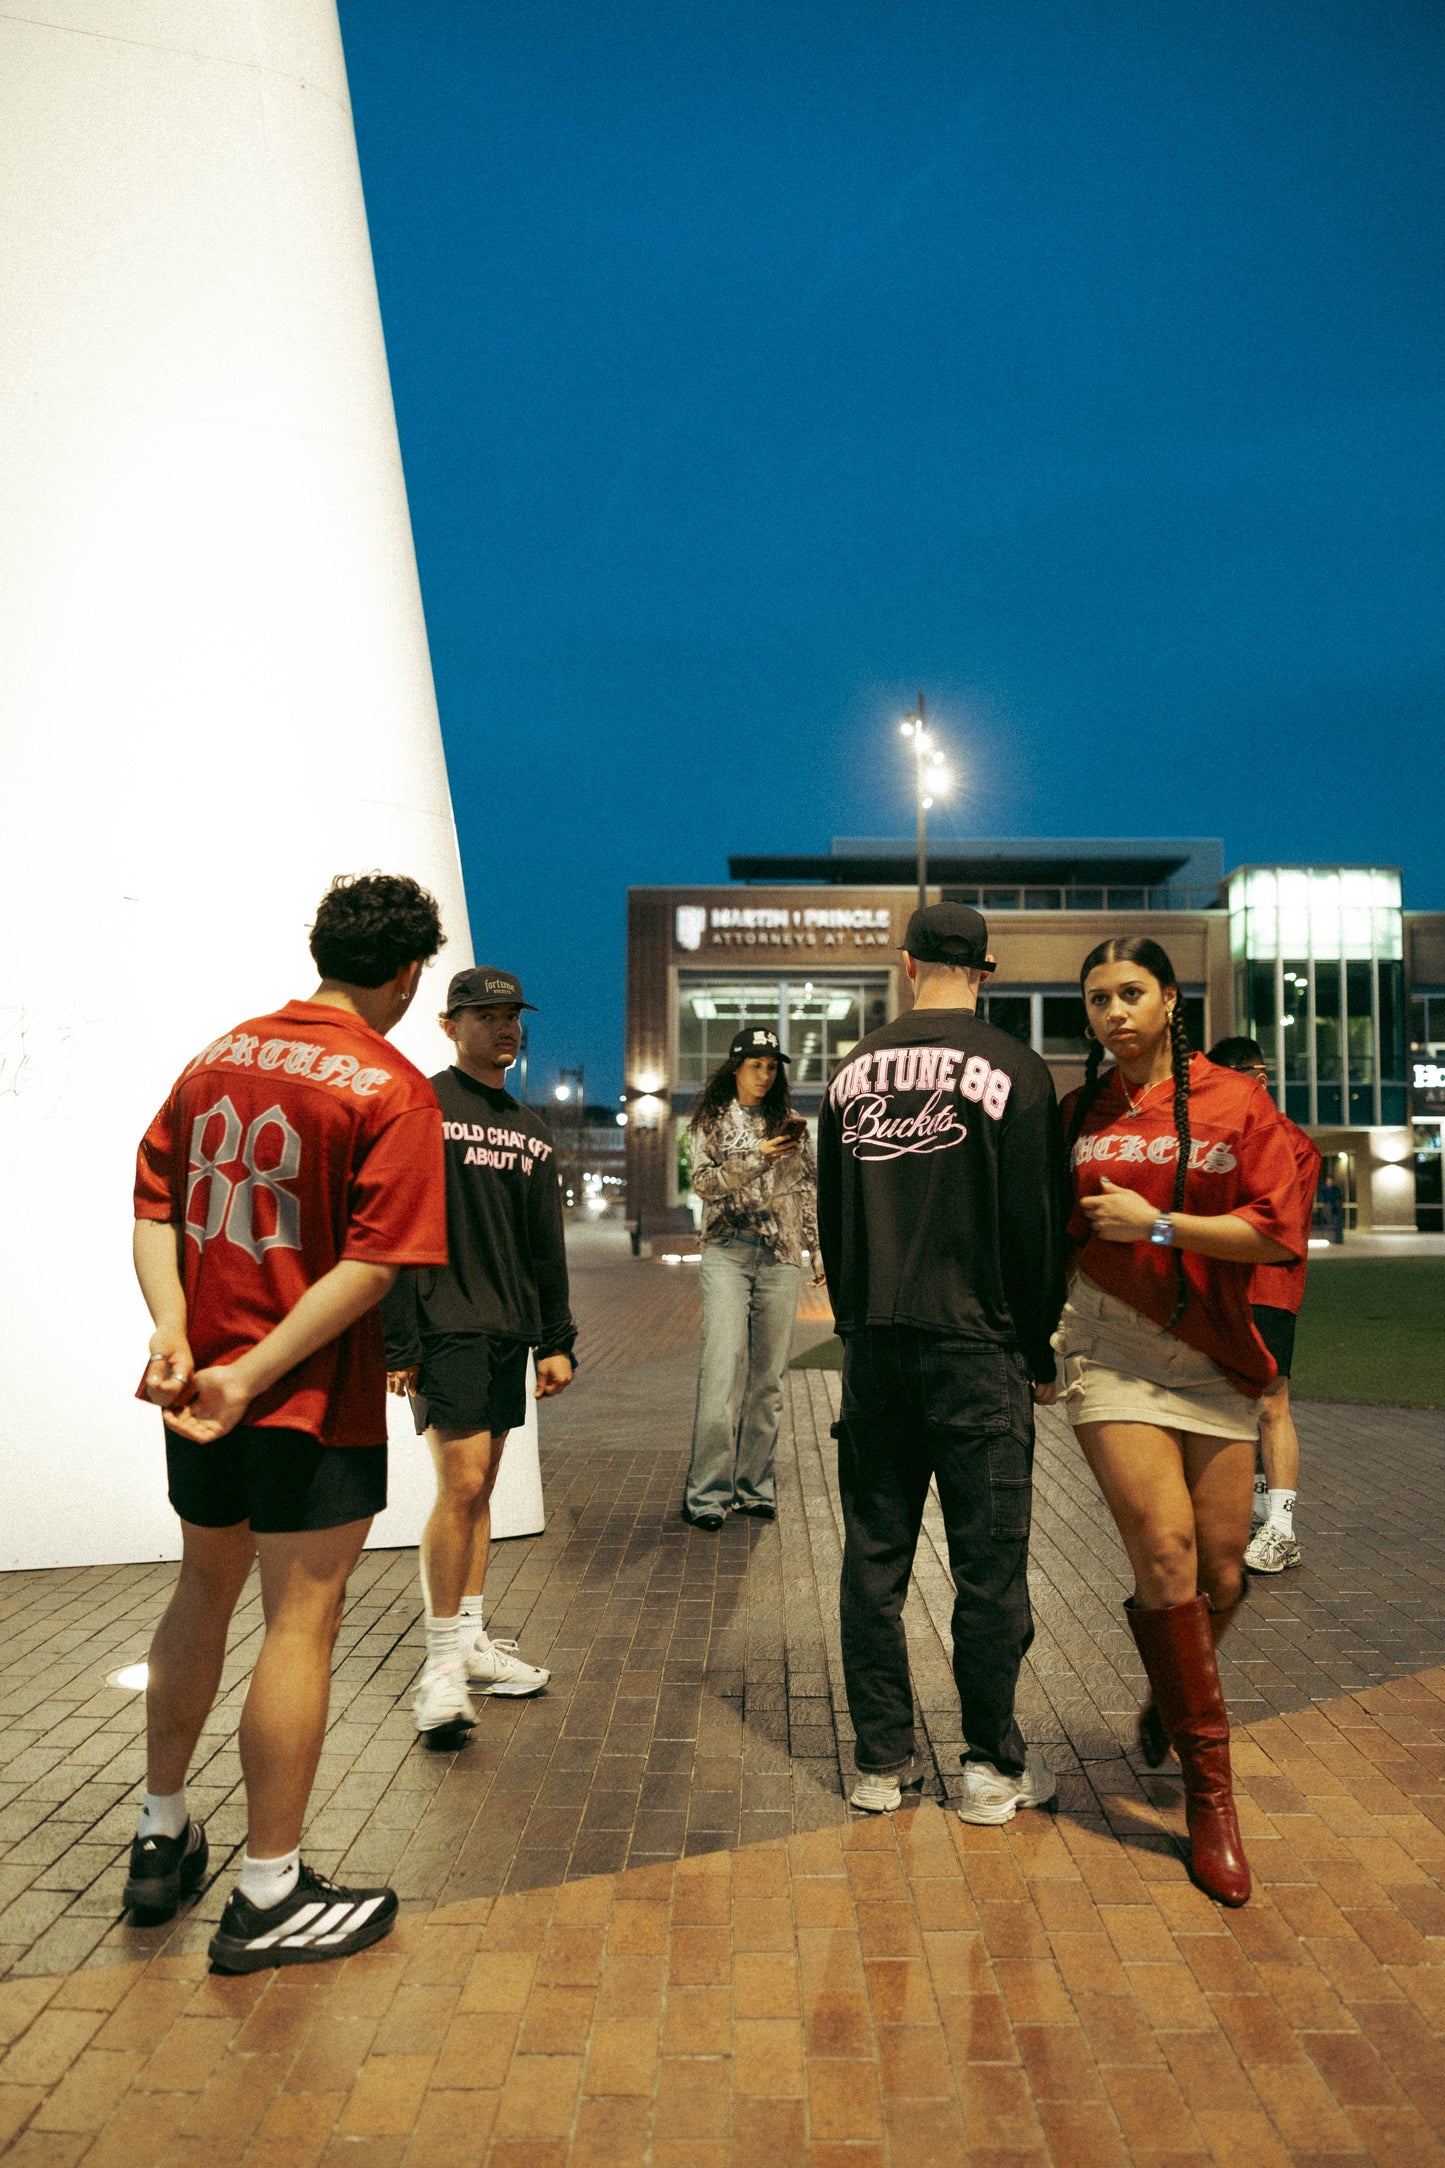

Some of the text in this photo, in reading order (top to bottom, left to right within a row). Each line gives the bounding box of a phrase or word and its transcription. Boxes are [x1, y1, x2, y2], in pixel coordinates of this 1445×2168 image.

[711, 932, 890, 947] ATTORNEYS AT LAW
[484, 979, 516, 993] fortune
[959, 1055, 1012, 1121] 88
[442, 1121, 485, 1142] TOLD
[487, 1127, 526, 1150] CHAT
[463, 1146, 518, 1171] ABOUT
[1070, 1134, 1237, 1174] UCKETS
[185, 1095, 302, 1265] 88
